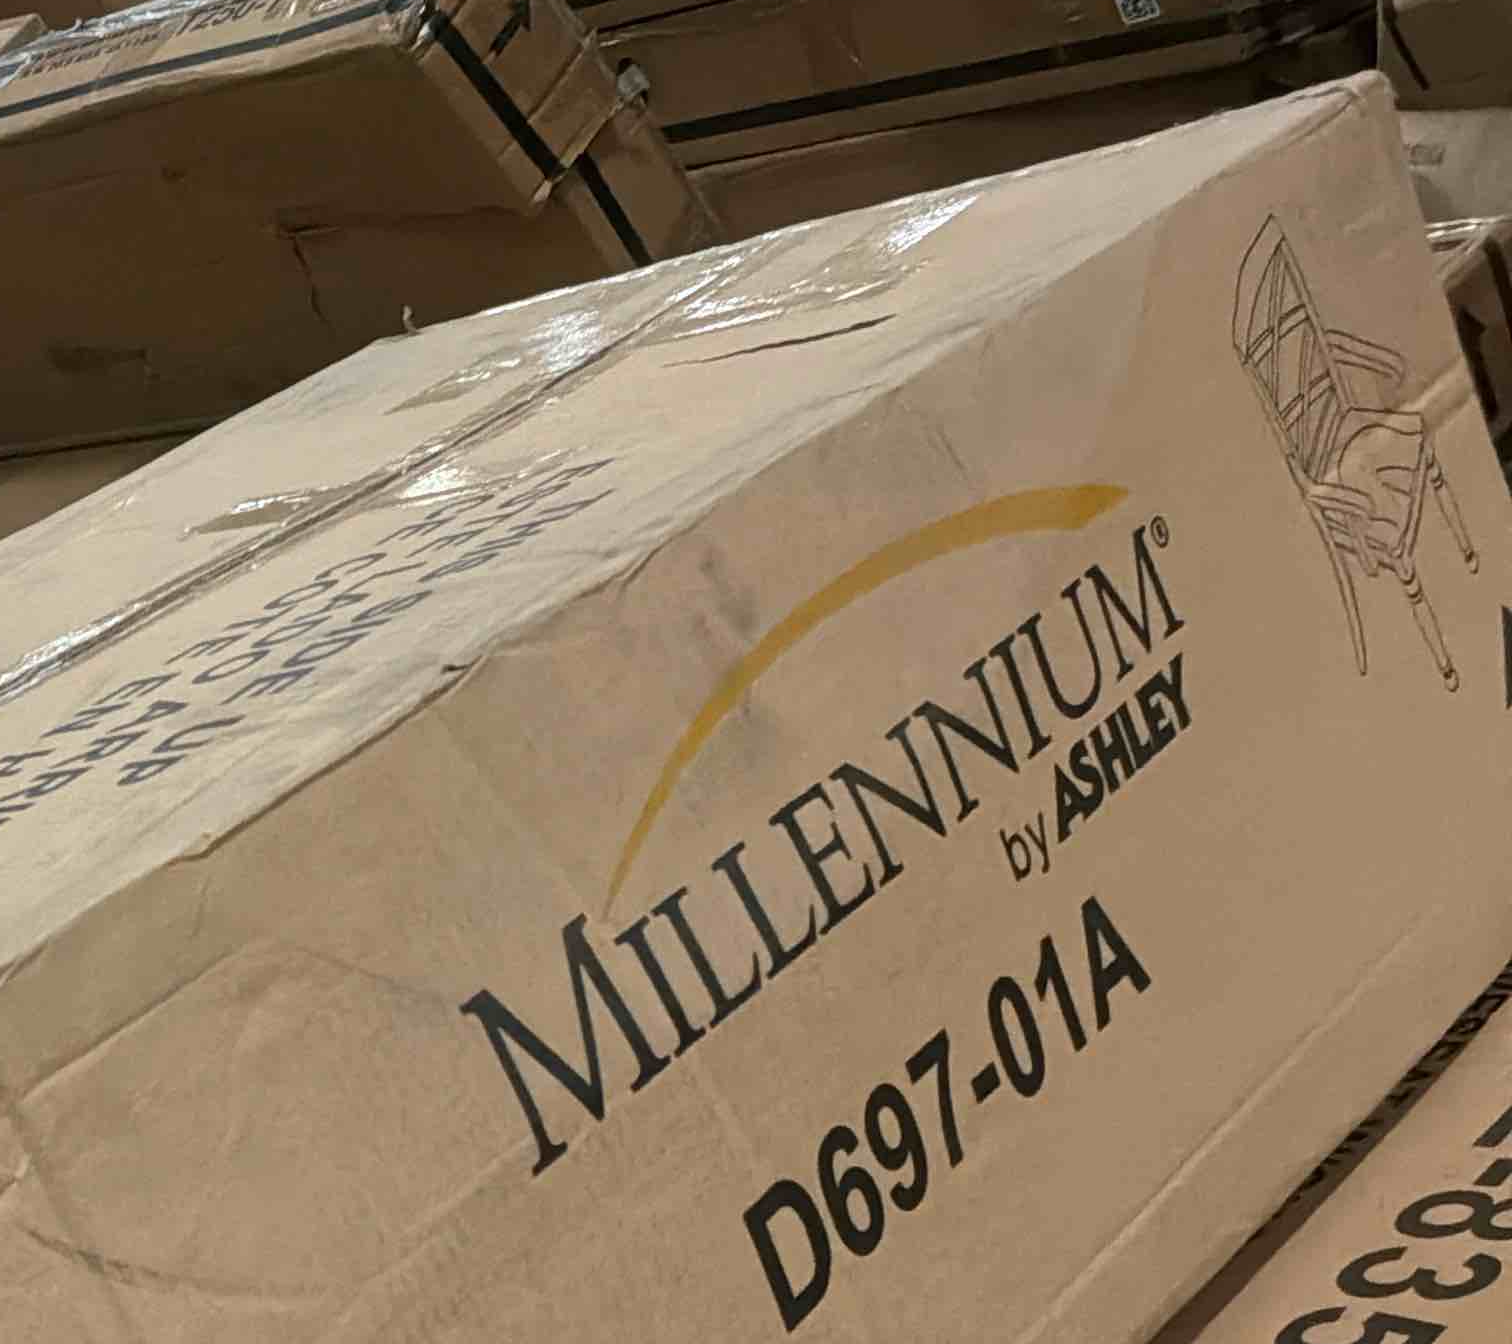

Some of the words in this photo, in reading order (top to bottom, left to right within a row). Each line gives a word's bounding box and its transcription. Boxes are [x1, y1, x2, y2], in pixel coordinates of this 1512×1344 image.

[375, 493, 496, 546] CE
[405, 457, 616, 558] ESTE
[418, 488, 616, 583] THIS
[165, 552, 388, 665] COTE
[190, 561, 428, 687] LADO
[217, 589, 433, 704] SIDE
[43, 671, 178, 738] EN
[116, 713, 246, 787] UP
[999, 810, 1053, 883] by
[1052, 652, 1194, 844] ASHLEY
[742, 895, 1152, 1334] D697-01A
